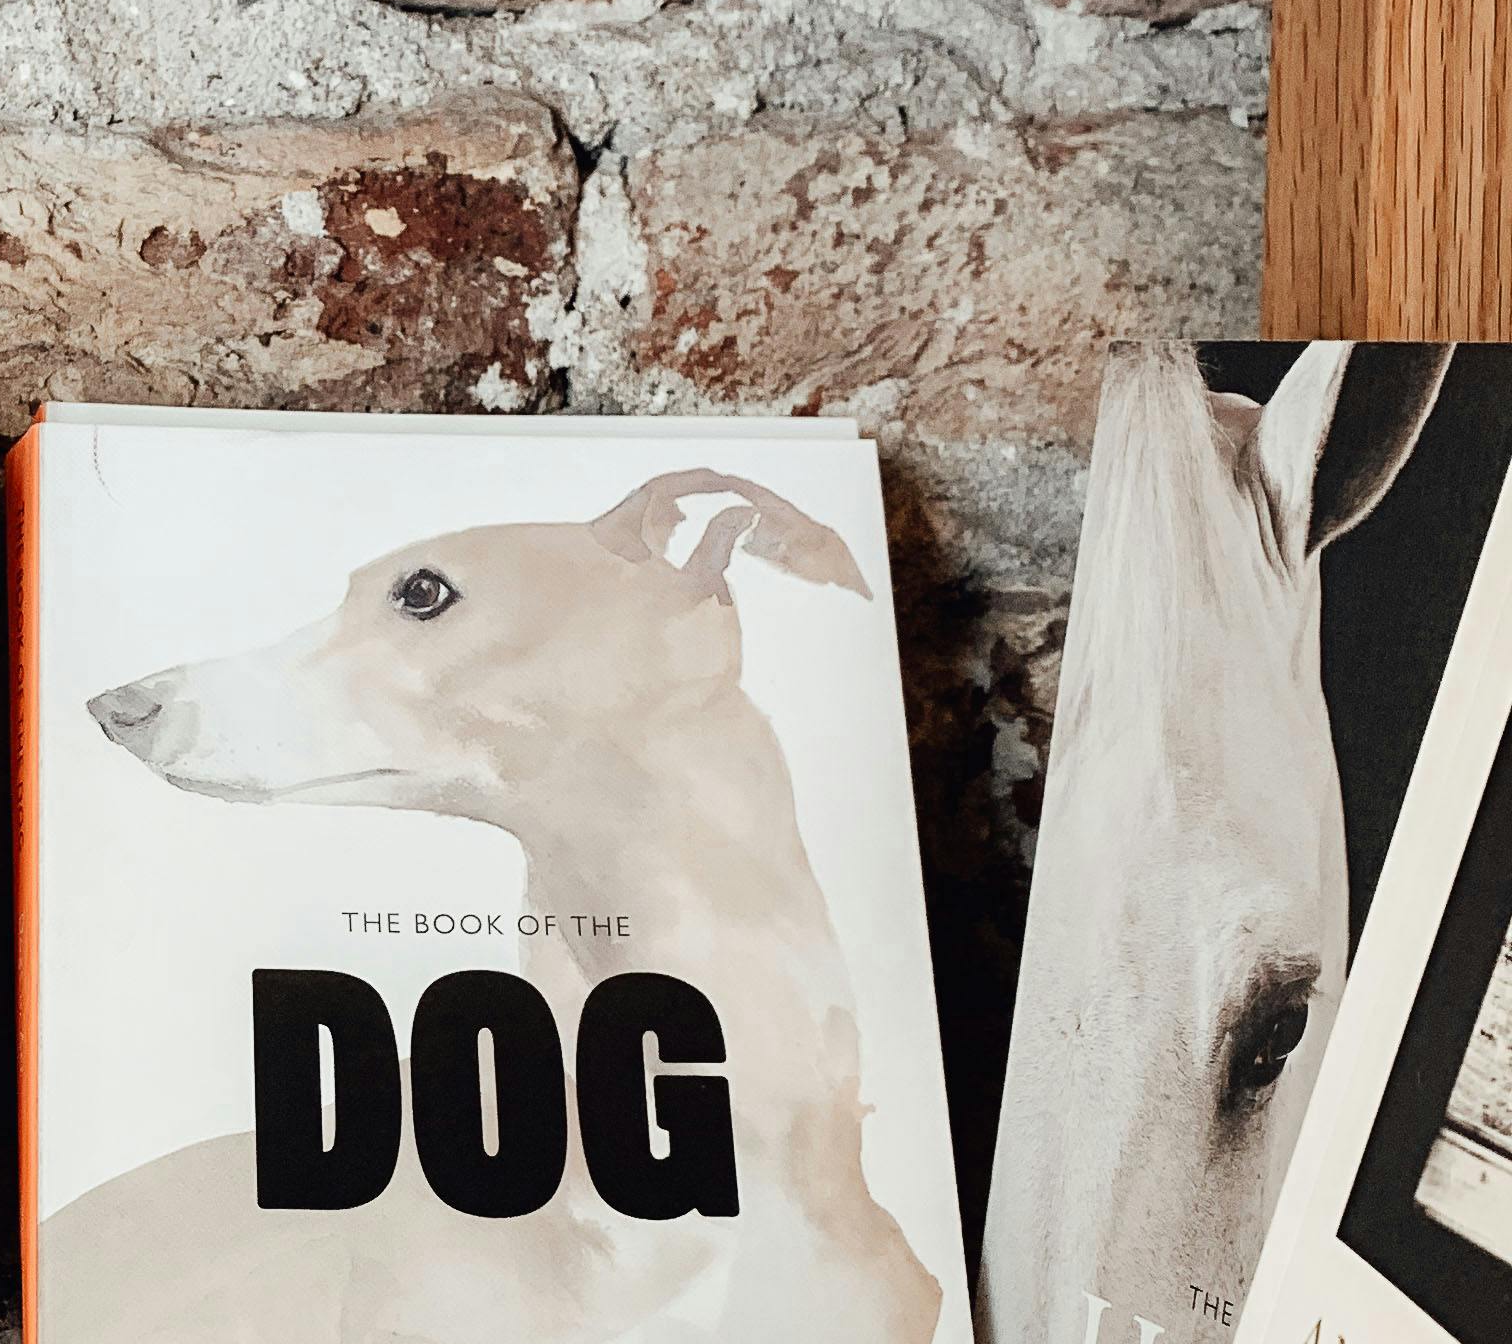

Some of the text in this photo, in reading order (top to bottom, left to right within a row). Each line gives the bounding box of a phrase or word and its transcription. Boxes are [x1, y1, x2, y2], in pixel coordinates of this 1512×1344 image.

[341, 911, 632, 938] THE BOOK OF THE
[252, 968, 740, 1221] DOG
[1189, 1284, 1234, 1327] THE
